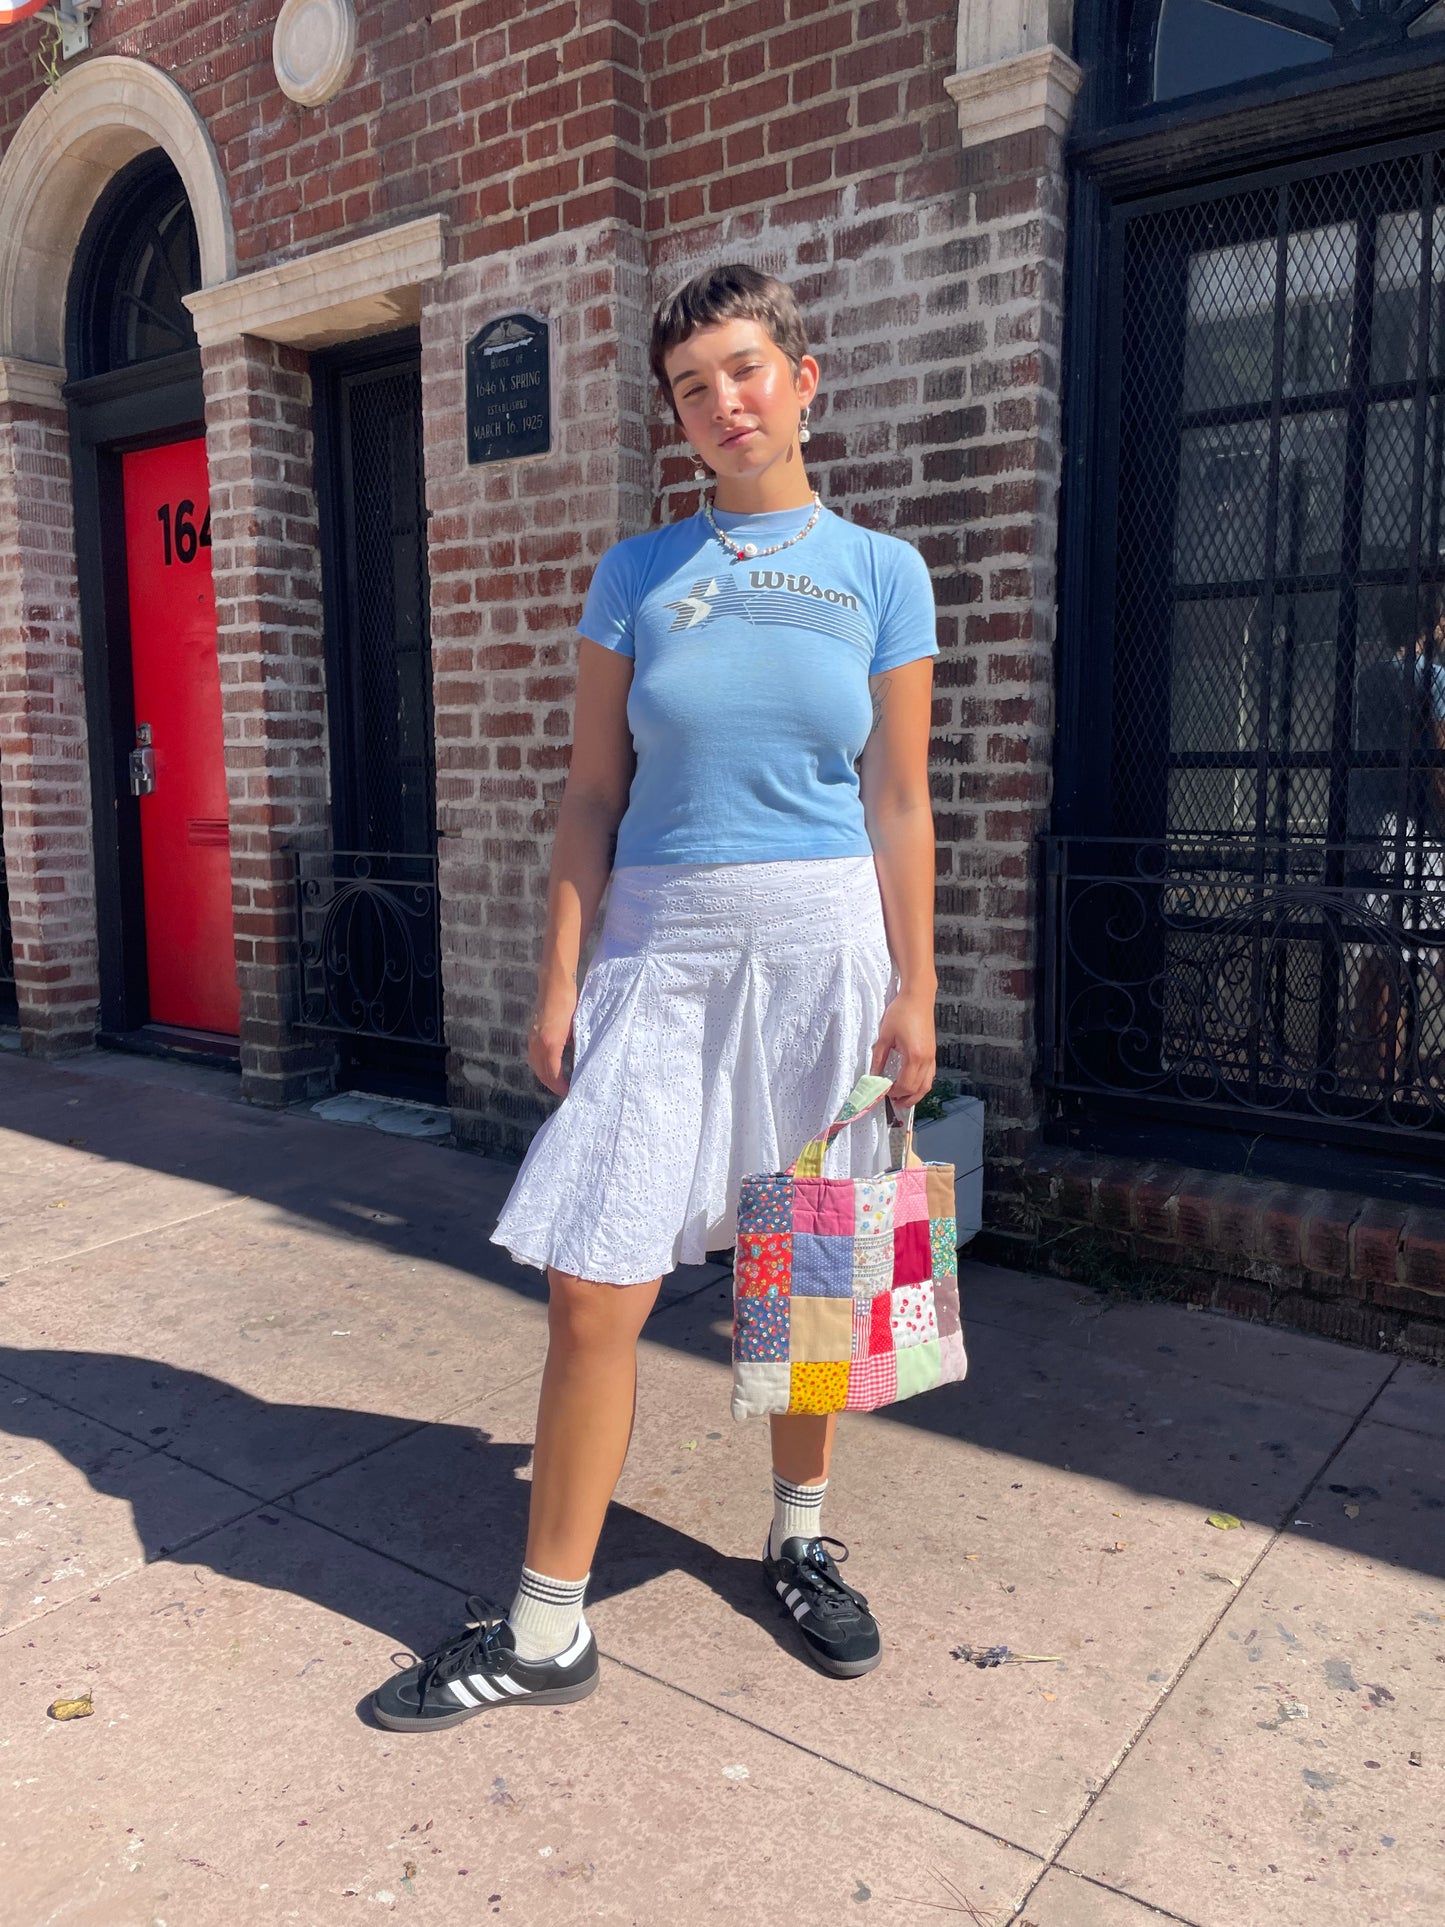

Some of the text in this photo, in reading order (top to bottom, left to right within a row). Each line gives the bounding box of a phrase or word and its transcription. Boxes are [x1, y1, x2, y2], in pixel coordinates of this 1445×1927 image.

[476, 381, 496, 398] 1646
[510, 370, 541, 390] SPRING
[487, 399, 528, 416] ESTABLISHED
[473, 421, 502, 440] MARCH
[522, 414, 543, 432] 1925
[749, 571, 859, 612] Wilson
